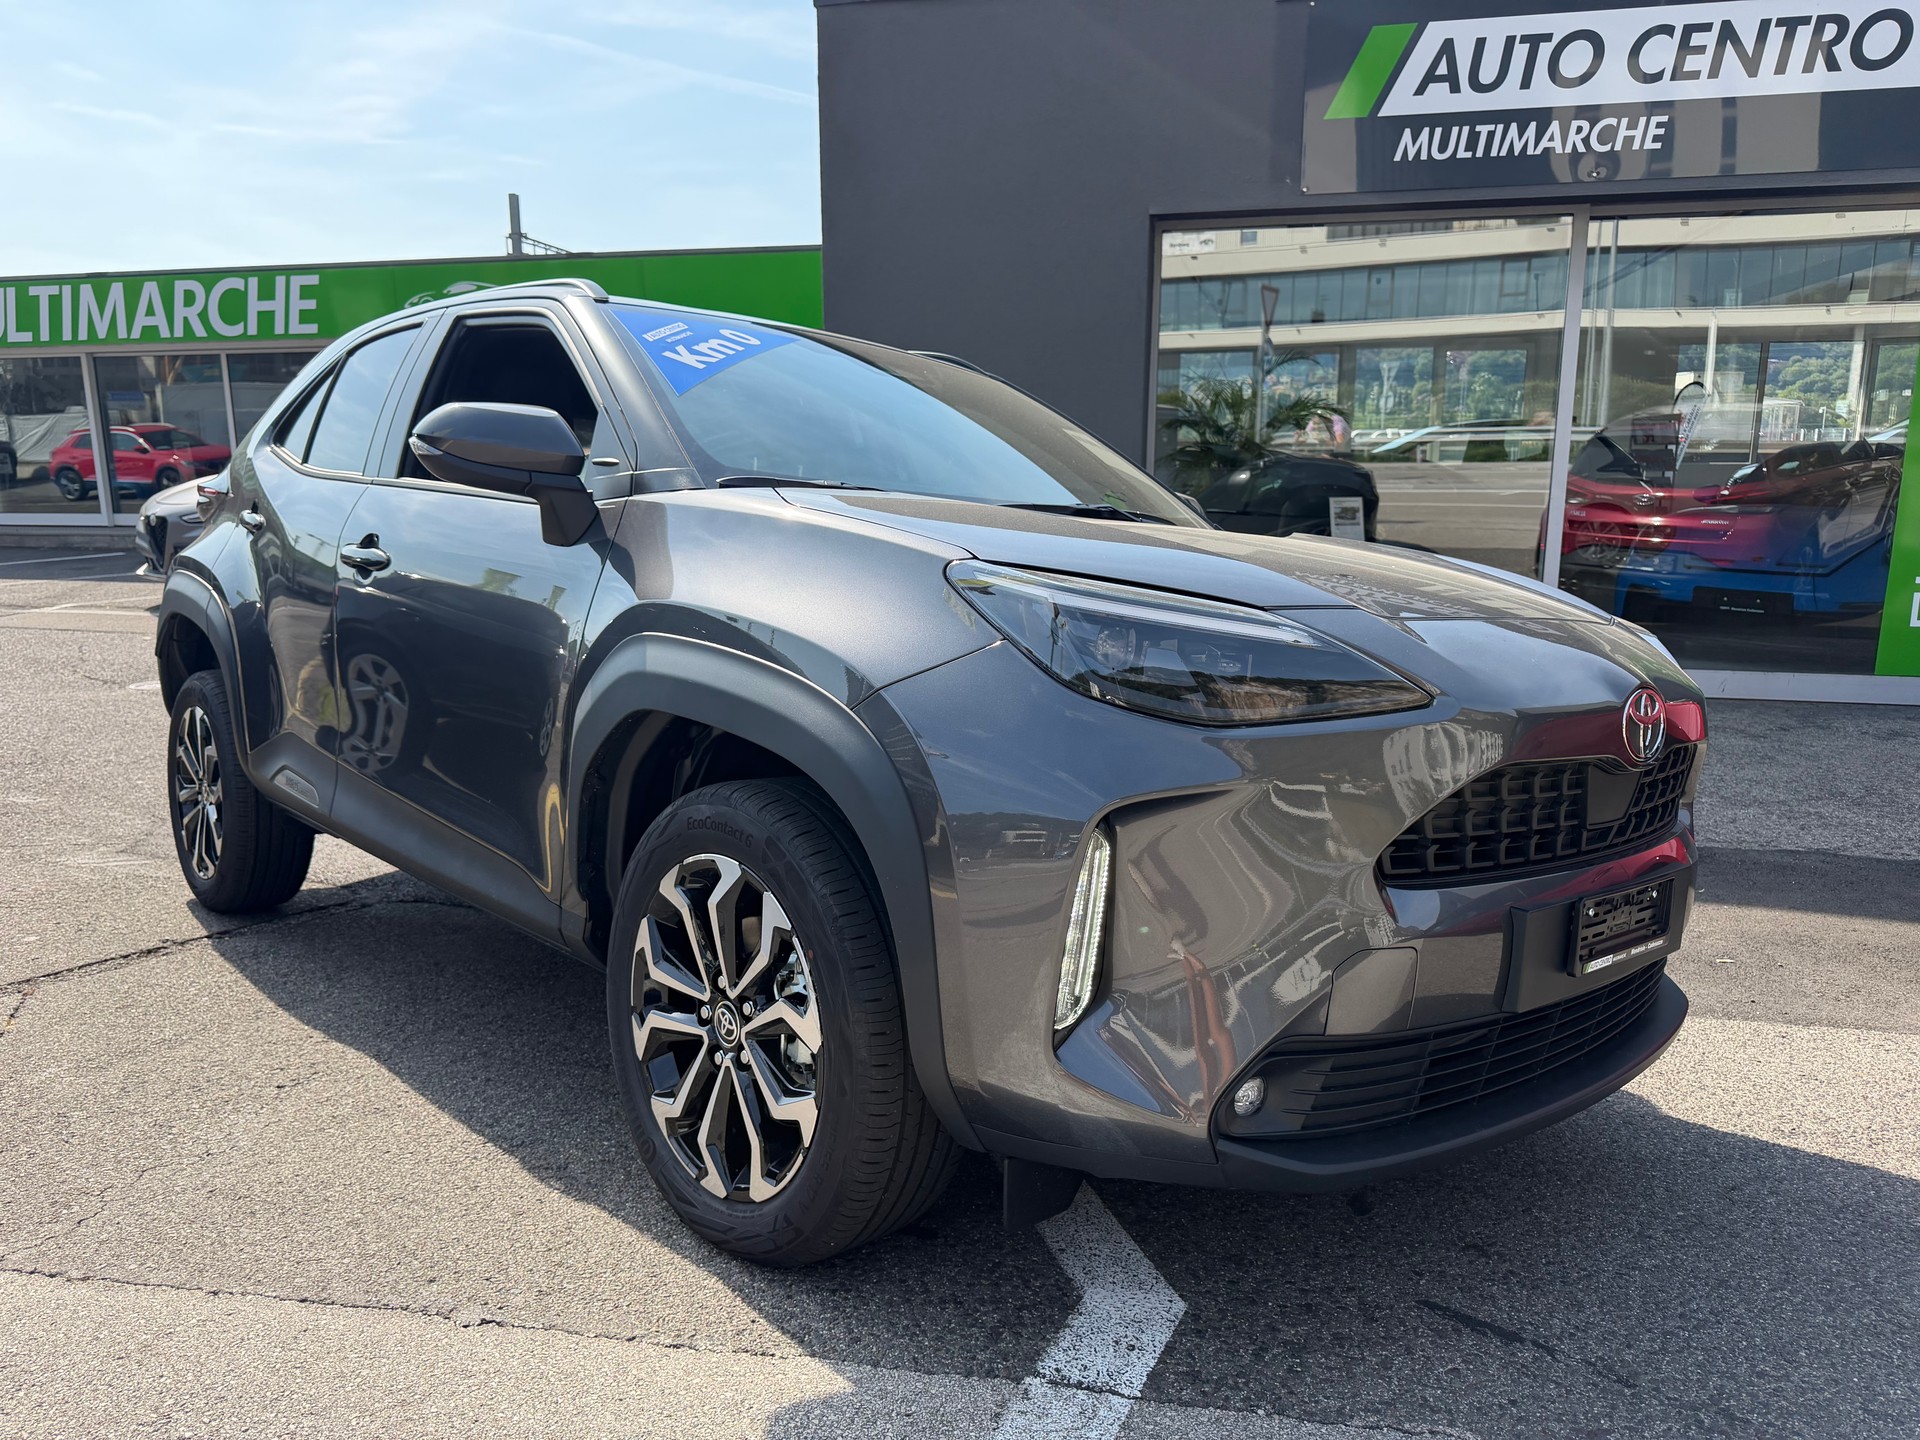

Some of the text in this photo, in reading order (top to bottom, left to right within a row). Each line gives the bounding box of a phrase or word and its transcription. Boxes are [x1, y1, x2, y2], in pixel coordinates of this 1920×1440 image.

[1413, 7, 1914, 97] AUTO CENTRO
[1393, 114, 1669, 162] MULTIMARCHE
[0, 274, 320, 343] LTIMARCHE
[662, 339, 744, 369] Km
[720, 329, 762, 346] 0
[687, 815, 754, 849] EcoContact 6
